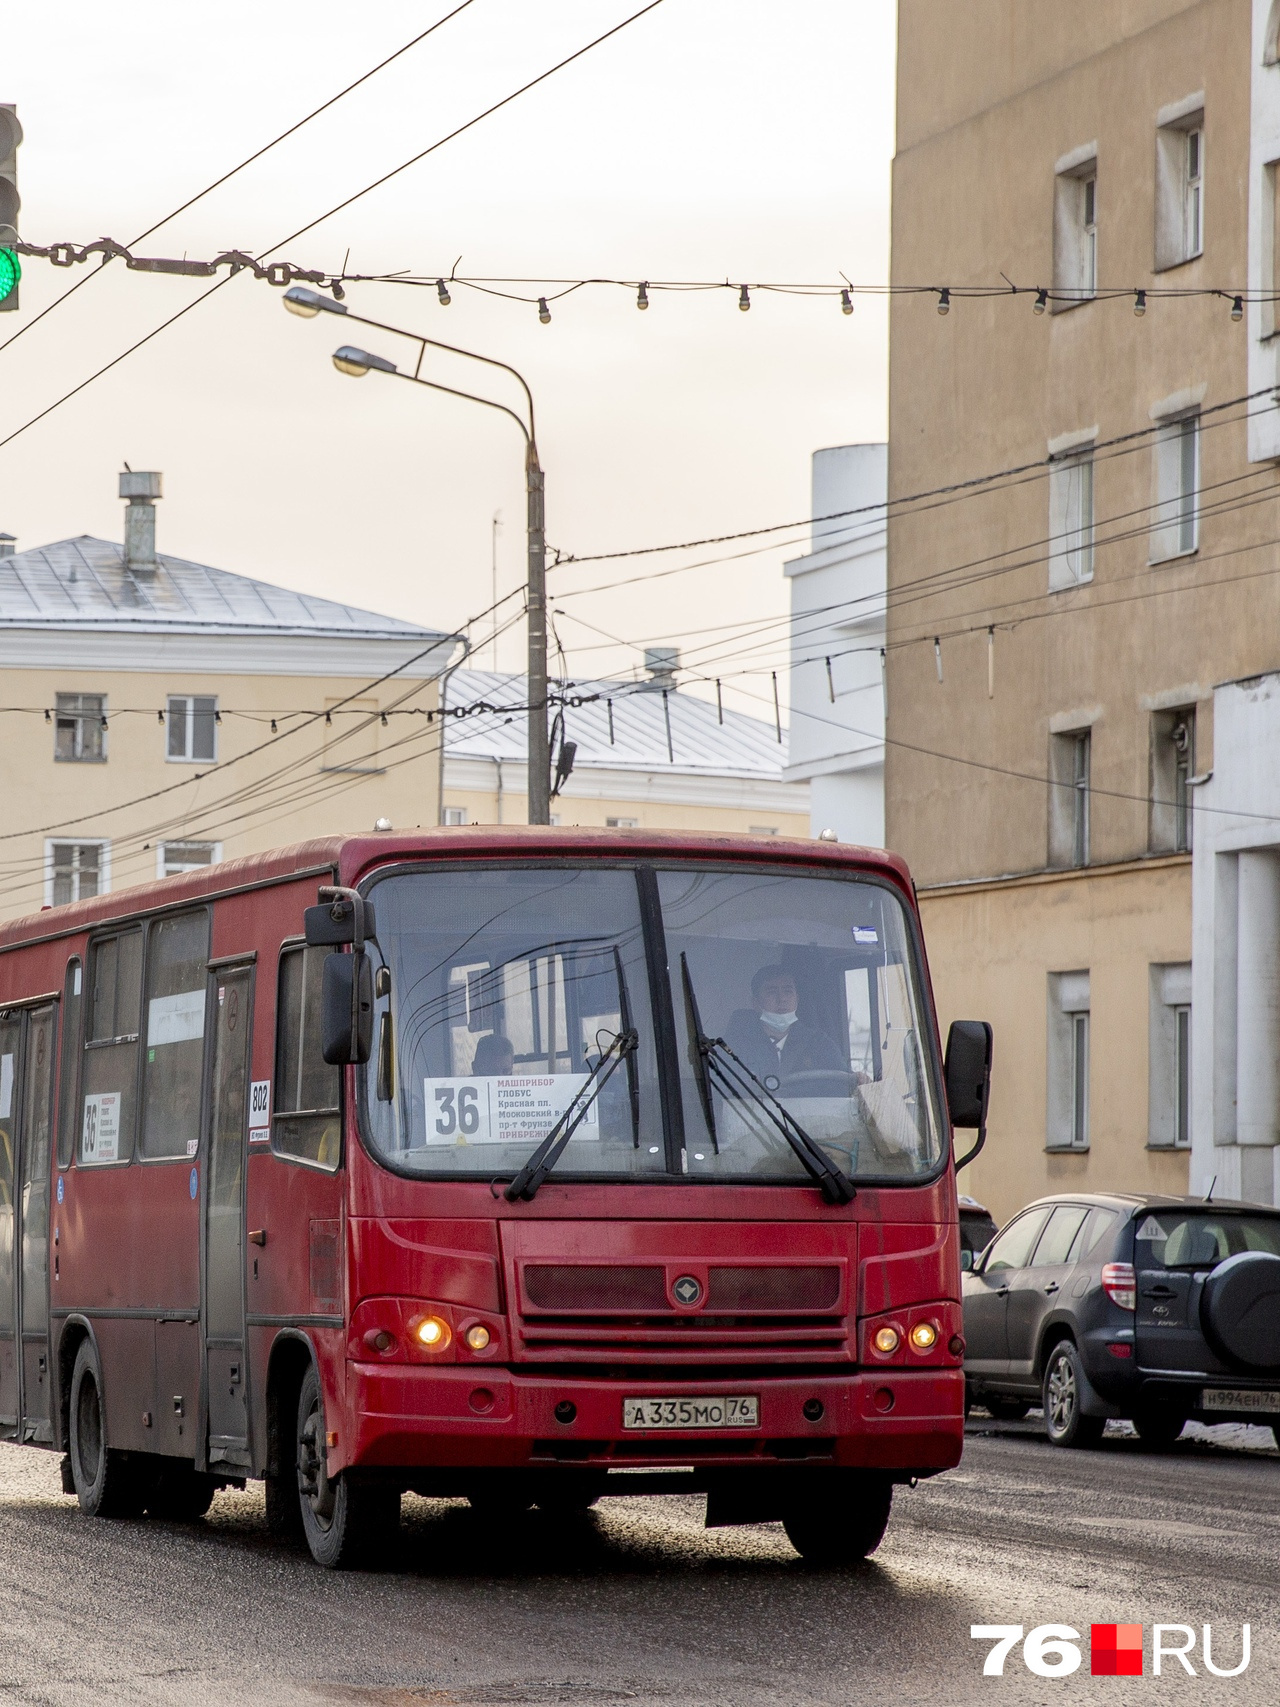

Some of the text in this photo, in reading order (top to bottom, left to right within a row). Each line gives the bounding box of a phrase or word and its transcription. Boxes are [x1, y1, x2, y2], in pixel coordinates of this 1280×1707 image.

[497, 1078, 555, 1088] МАШПРИБОР
[252, 1084, 268, 1112] 802
[497, 1089, 532, 1098] ГЛОБУС
[498, 1100, 535, 1109] Красная
[434, 1086, 480, 1136] 36
[498, 1110, 552, 1119] Московский
[84, 1104, 97, 1153] 36
[498, 1120, 553, 1130] пр-т Фрунзе
[499, 1129, 552, 1139] ПРИБРЕЖН
[728, 1399, 750, 1416] 76
[727, 1416, 744, 1424] RUS
